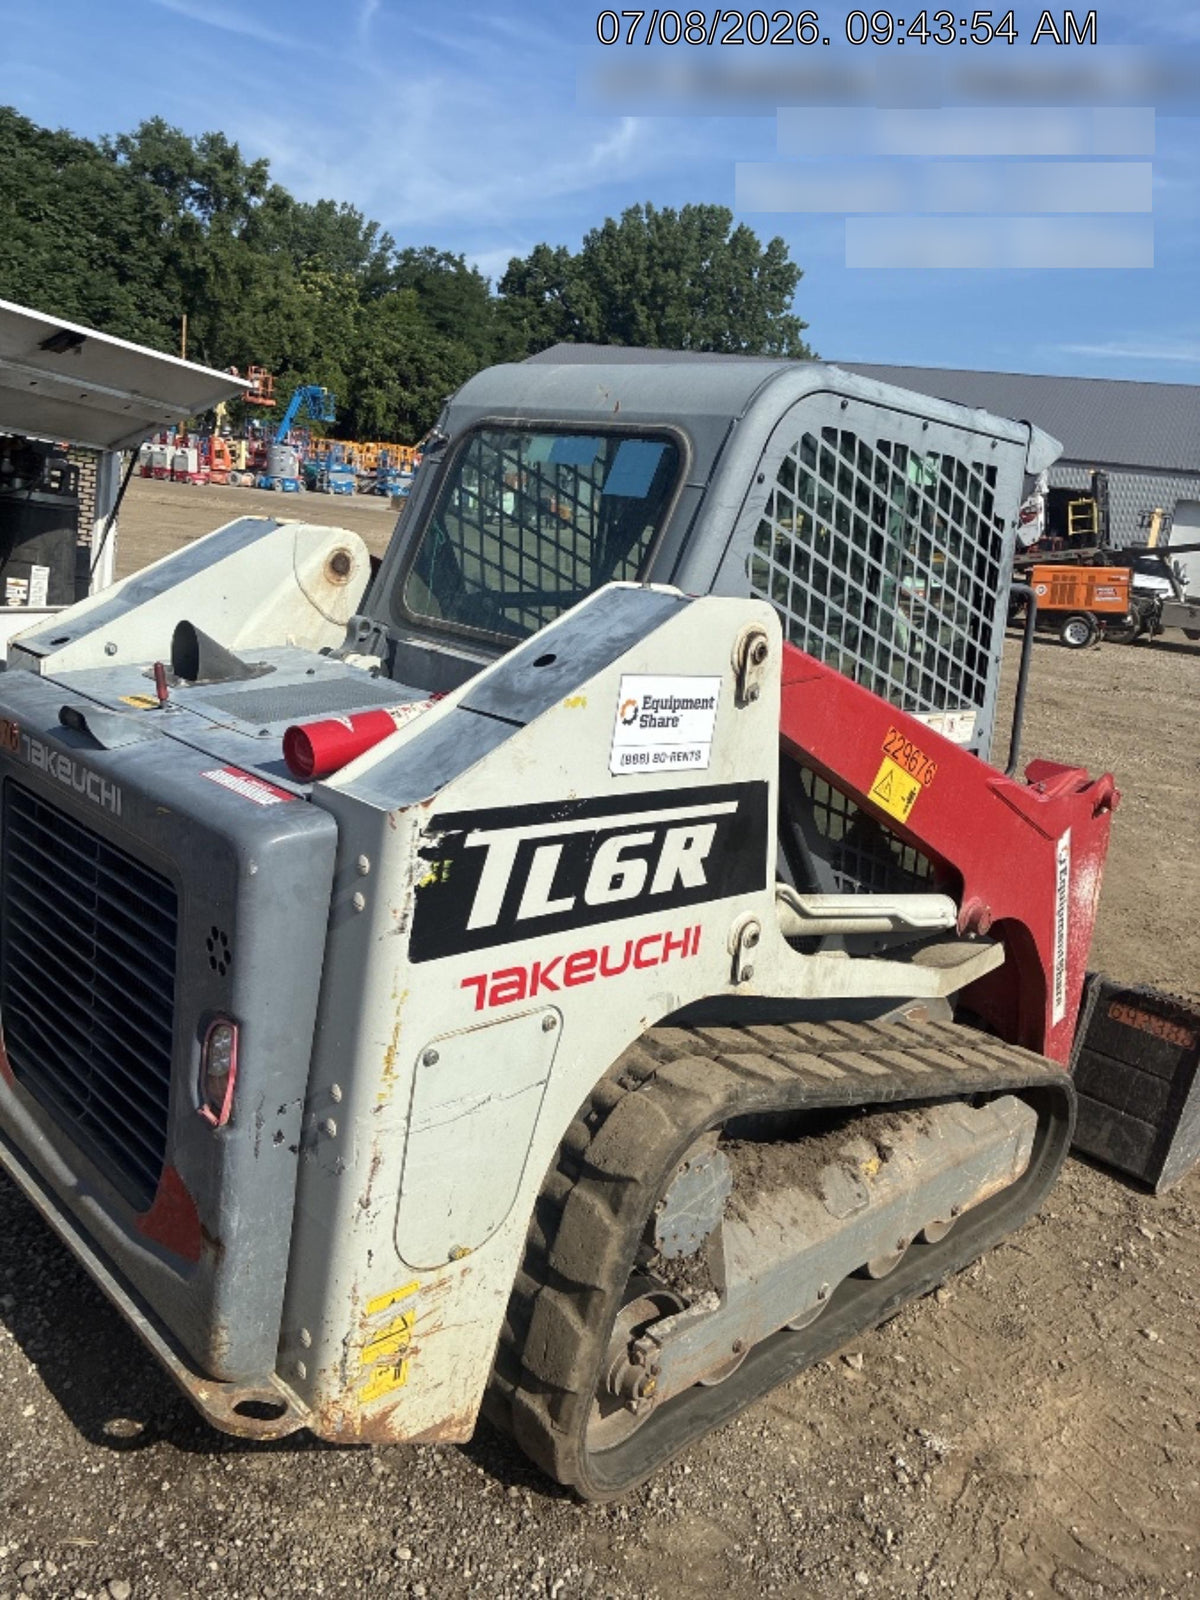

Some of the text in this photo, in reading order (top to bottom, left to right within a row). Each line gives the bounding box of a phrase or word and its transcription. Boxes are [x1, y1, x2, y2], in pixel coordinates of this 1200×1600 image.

[641, 695, 715, 713] Equipment
[883, 727, 936, 785] 229676
[463, 800, 739, 931] TL6R
